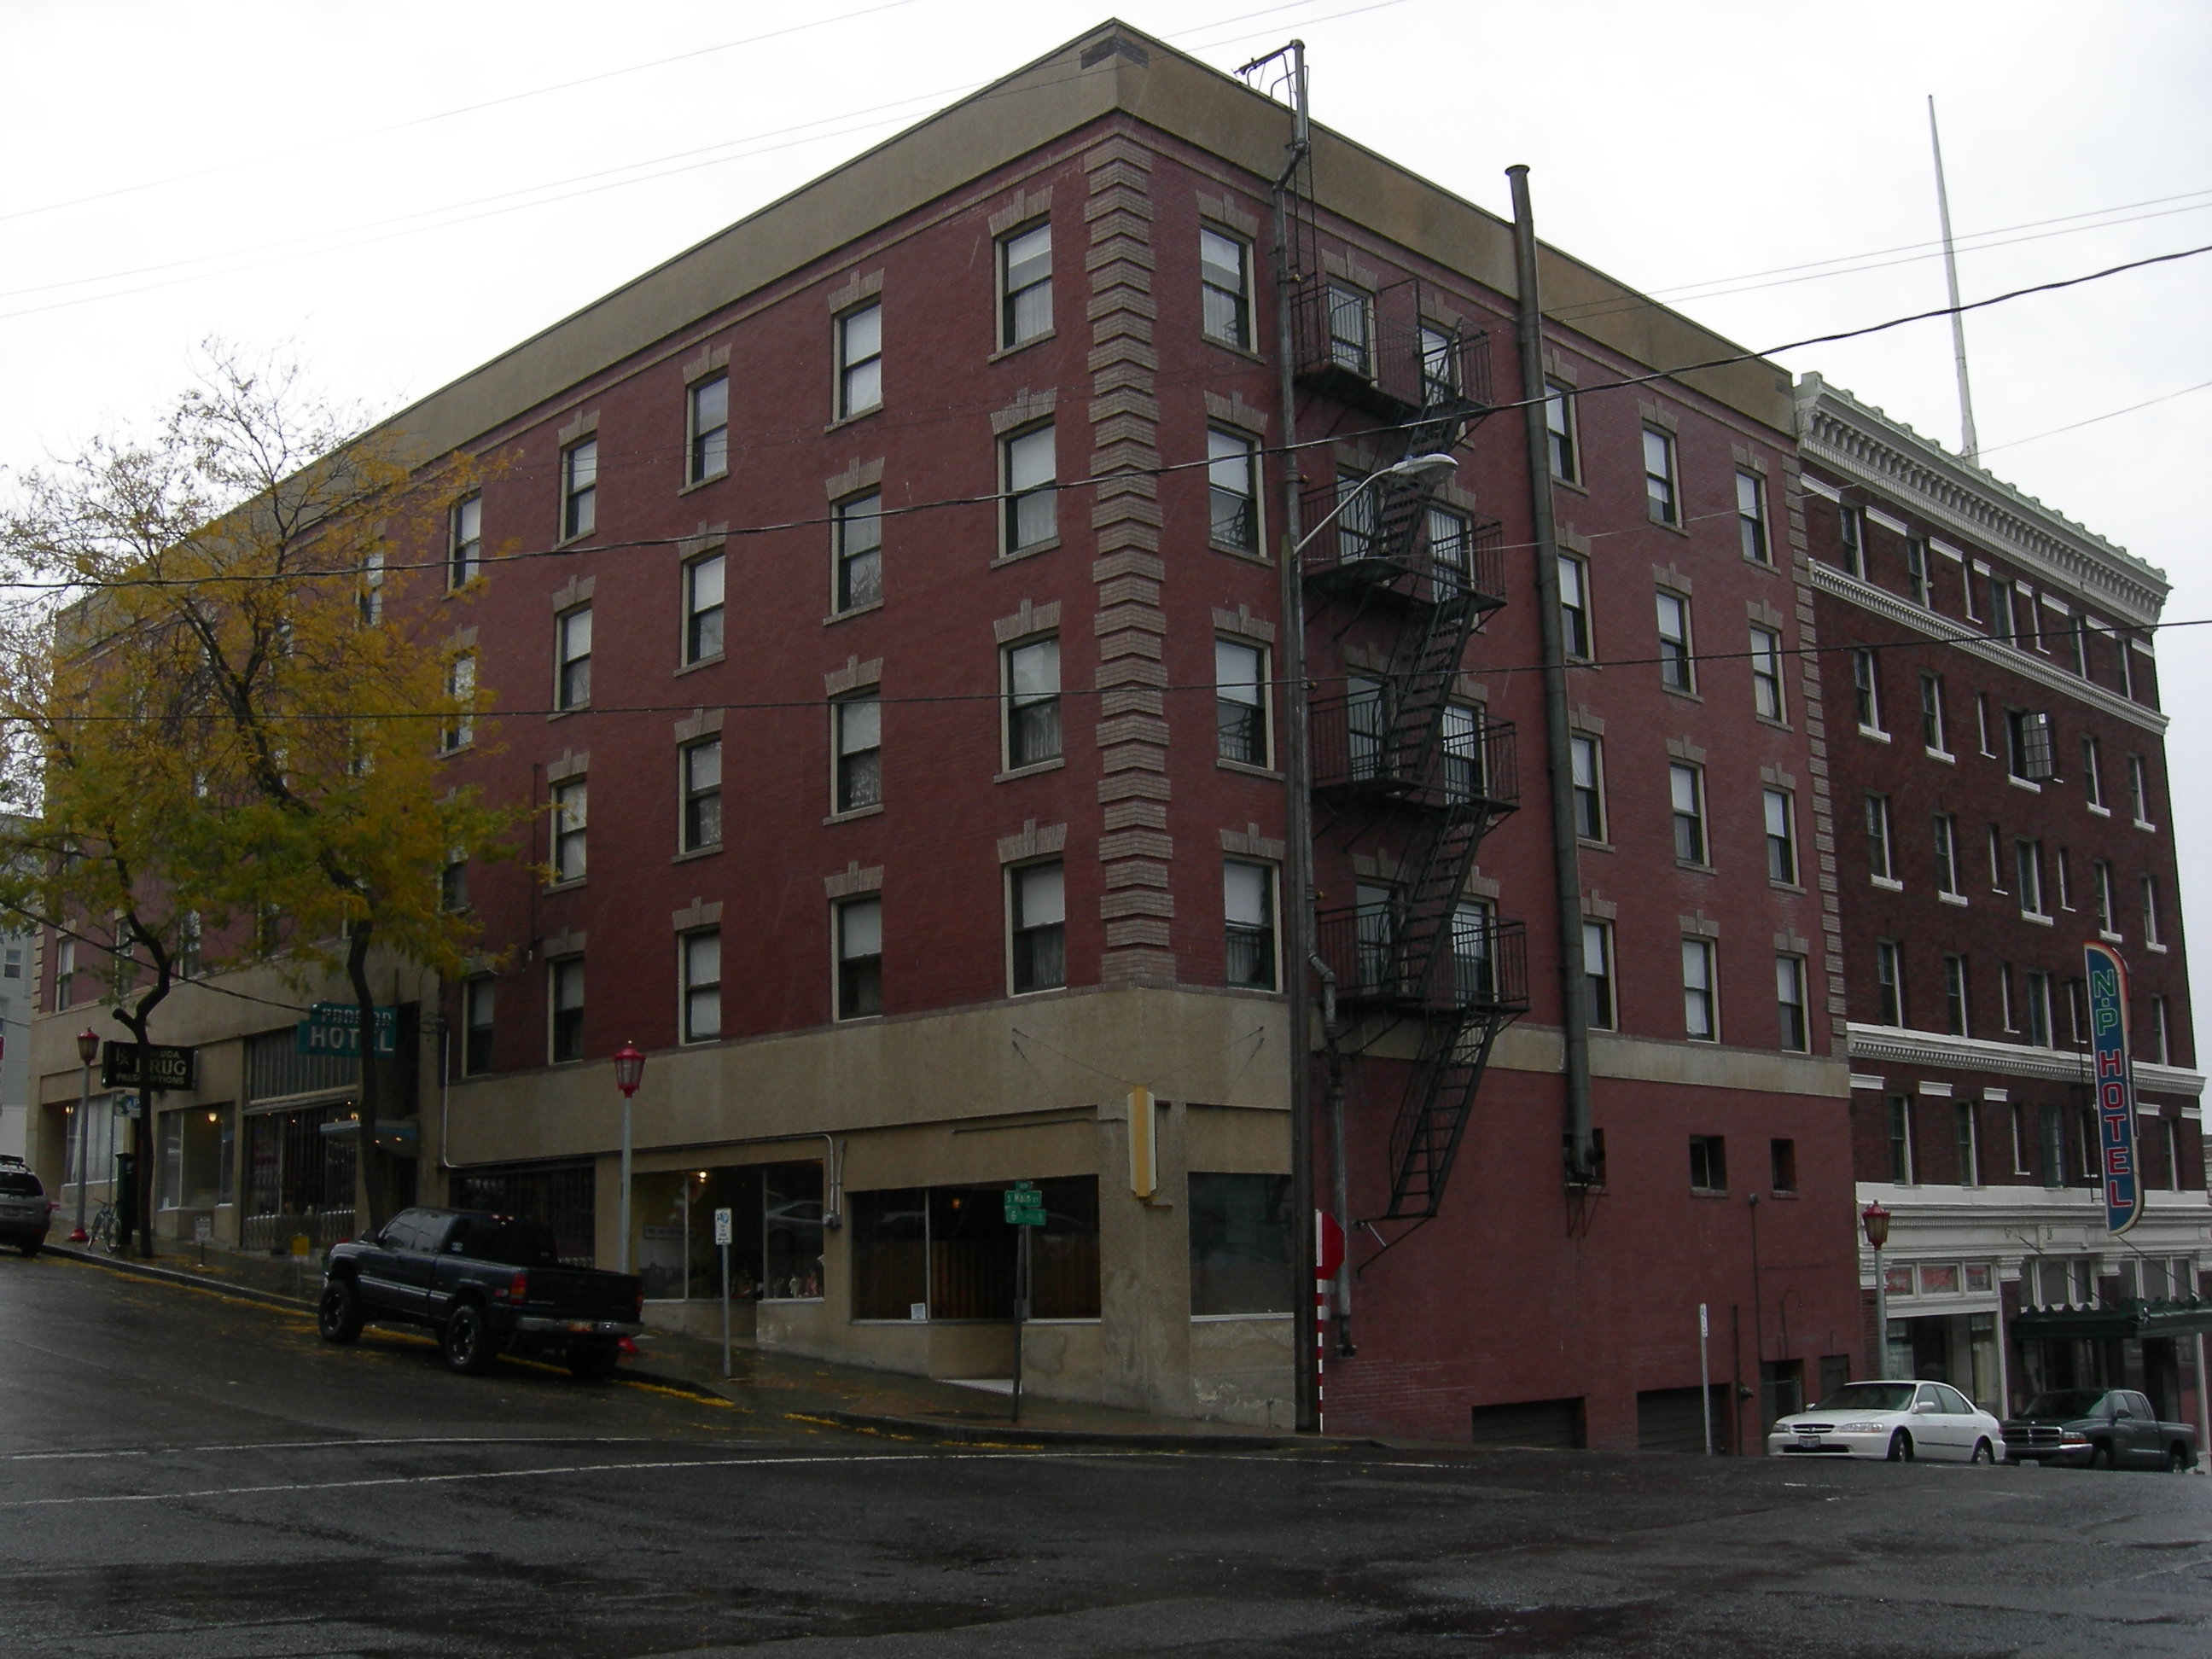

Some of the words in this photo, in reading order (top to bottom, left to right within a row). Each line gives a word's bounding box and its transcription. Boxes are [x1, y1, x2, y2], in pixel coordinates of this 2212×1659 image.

[310, 1026, 394, 1051] HOTL
[2098, 1049, 2133, 1208] HOTEL
[1014, 1193, 1031, 1203] Main
